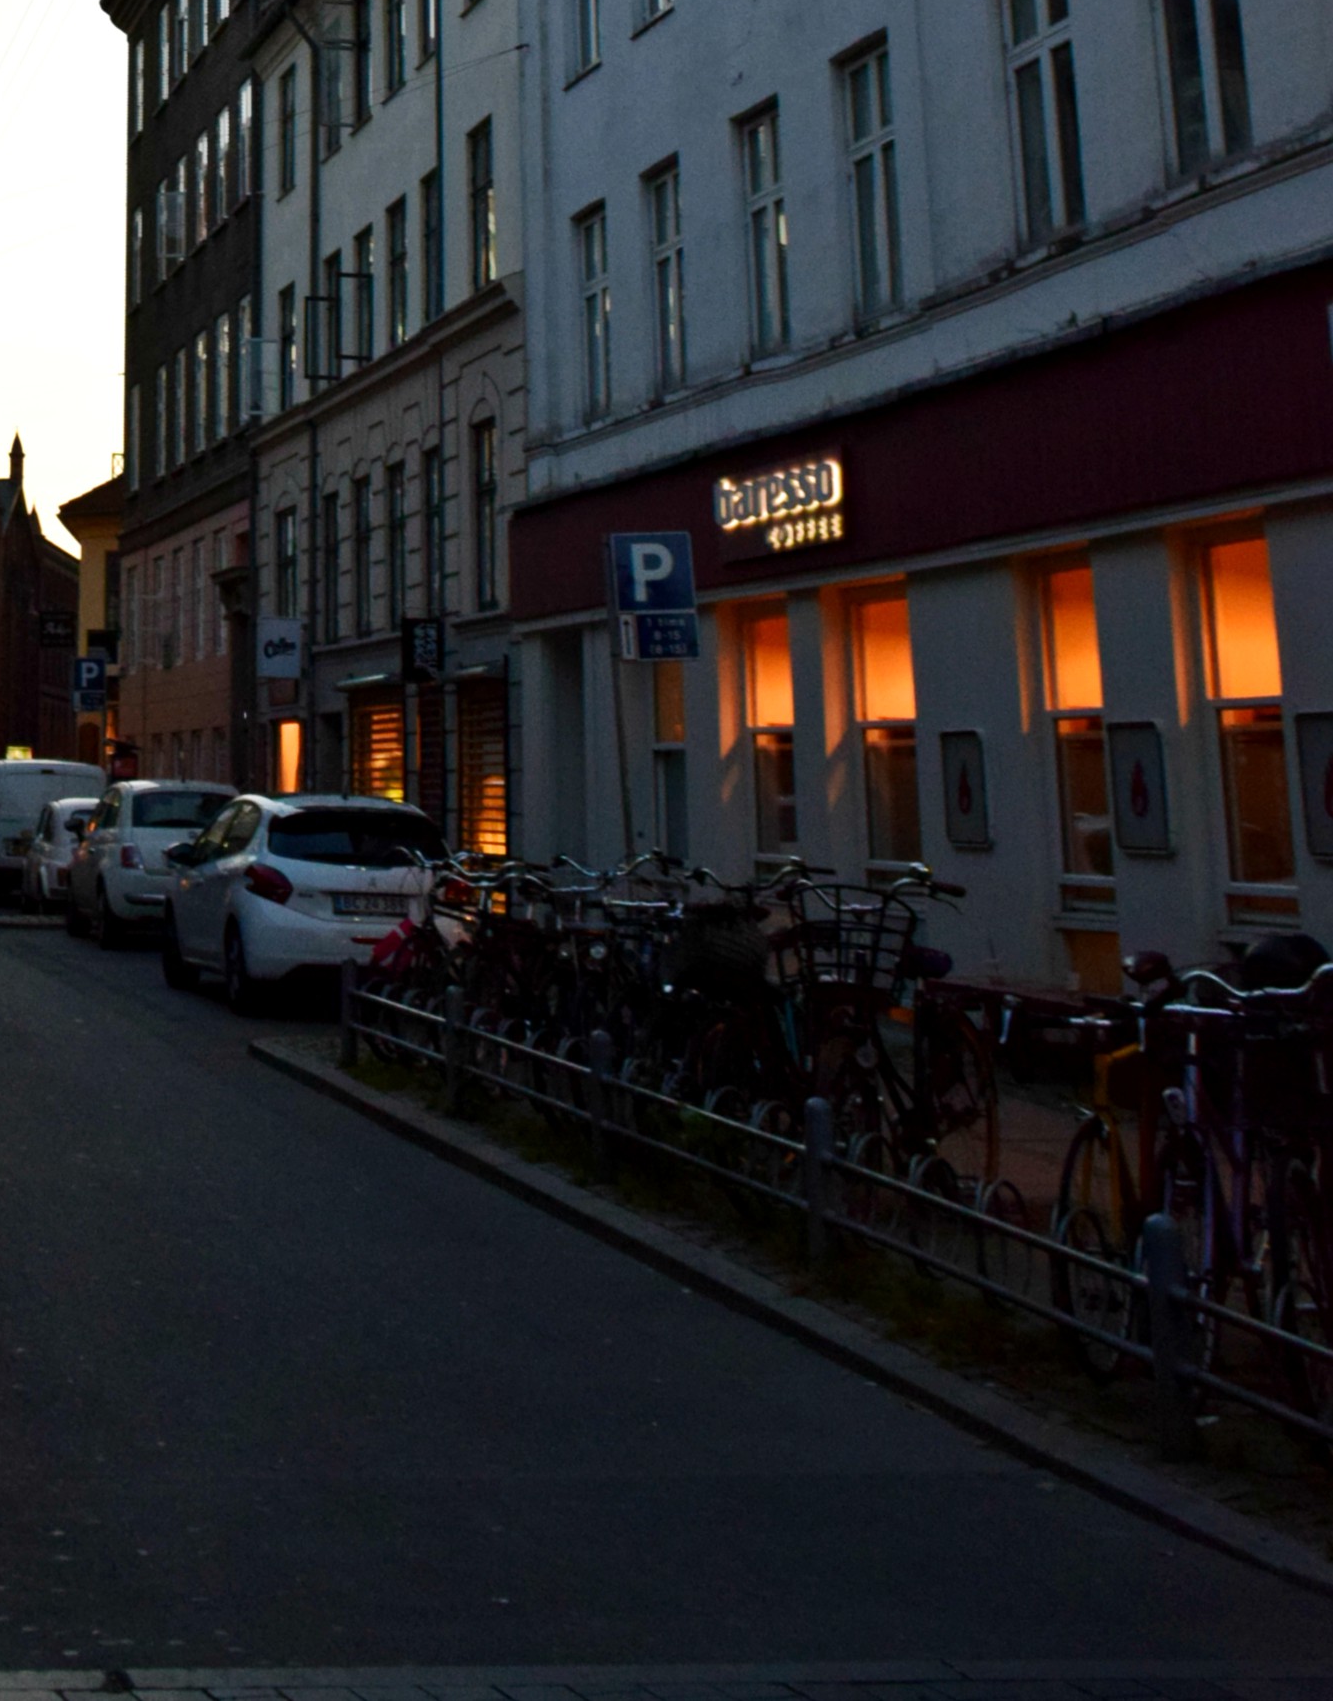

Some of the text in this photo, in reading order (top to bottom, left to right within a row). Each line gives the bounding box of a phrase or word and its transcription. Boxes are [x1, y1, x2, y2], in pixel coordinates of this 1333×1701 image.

[713, 460, 842, 529] baresso
[630, 542, 674, 602] P
[81, 661, 100, 688] P
